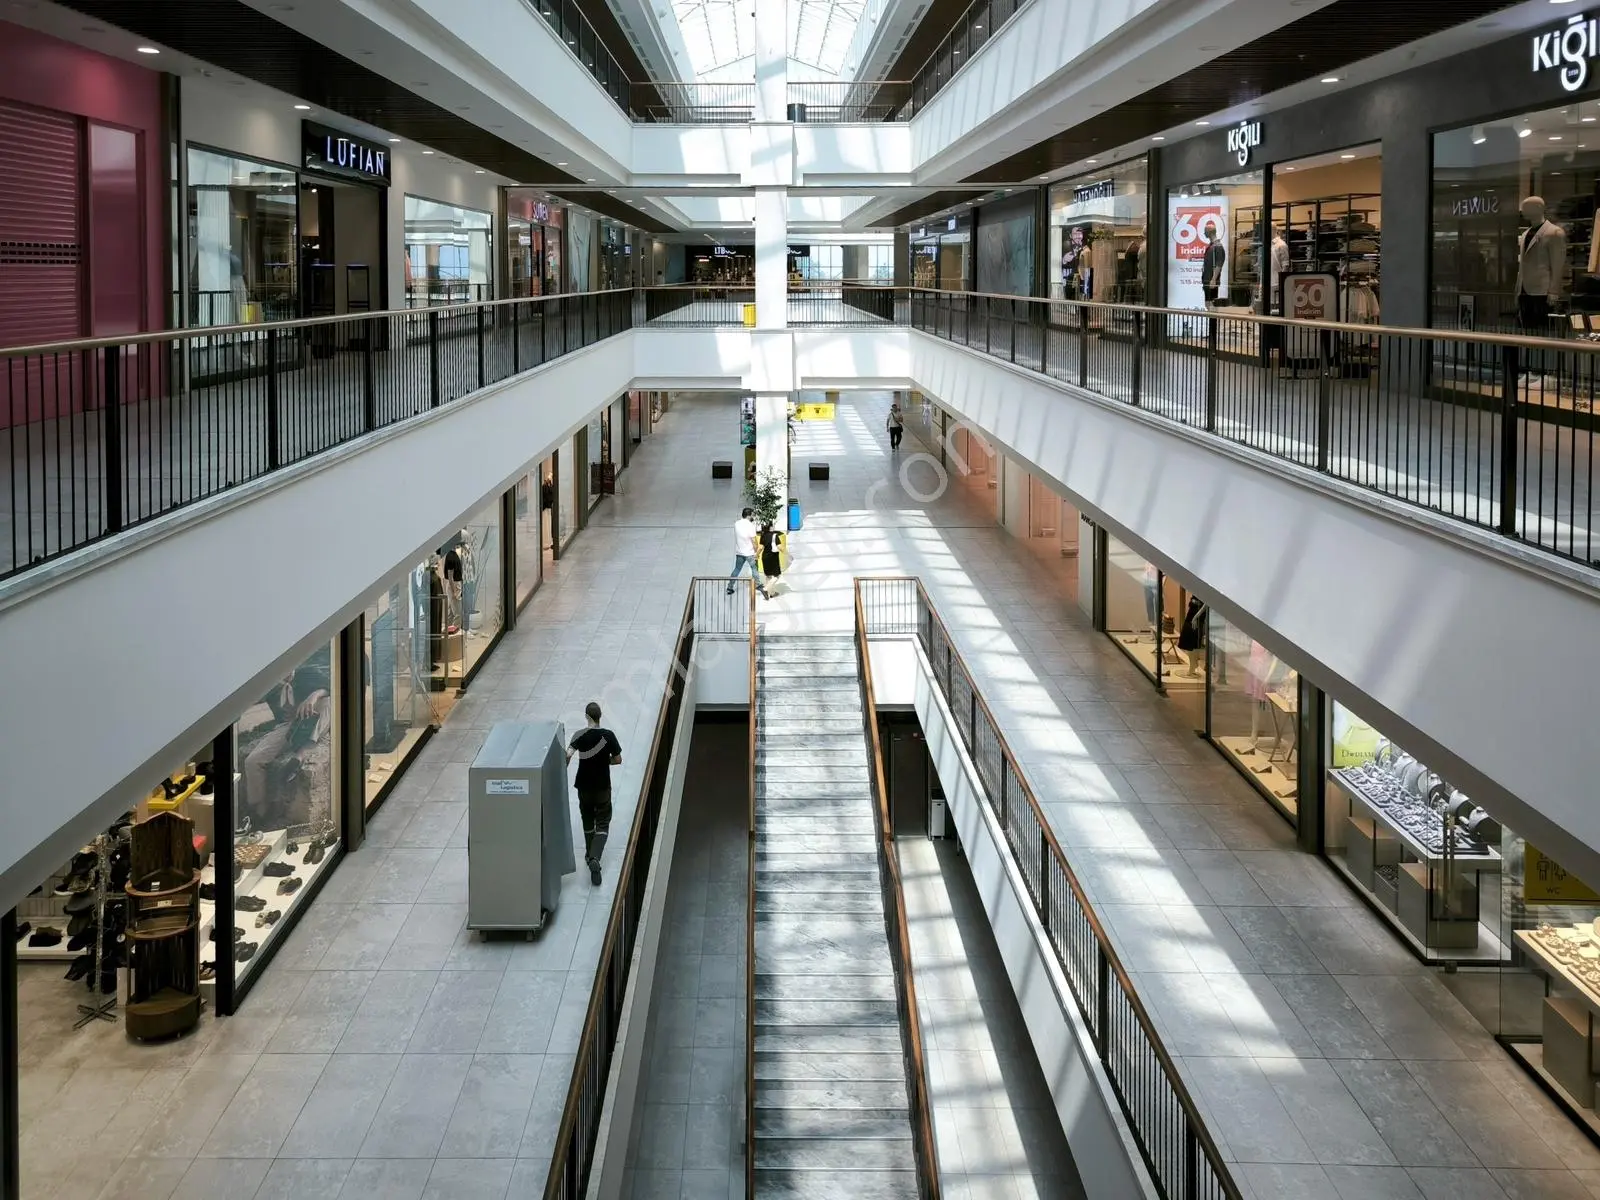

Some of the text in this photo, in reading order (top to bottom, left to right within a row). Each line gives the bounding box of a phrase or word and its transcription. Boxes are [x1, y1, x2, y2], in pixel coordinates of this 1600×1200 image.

[326, 135, 385, 177] LUFIAN
[714, 246, 726, 255] LTB
[1180, 246, 1206, 255] indiri
[1293, 283, 1326, 307] 60
[1297, 307, 1322, 315] indirim
[1546, 886, 1562, 895] WC
